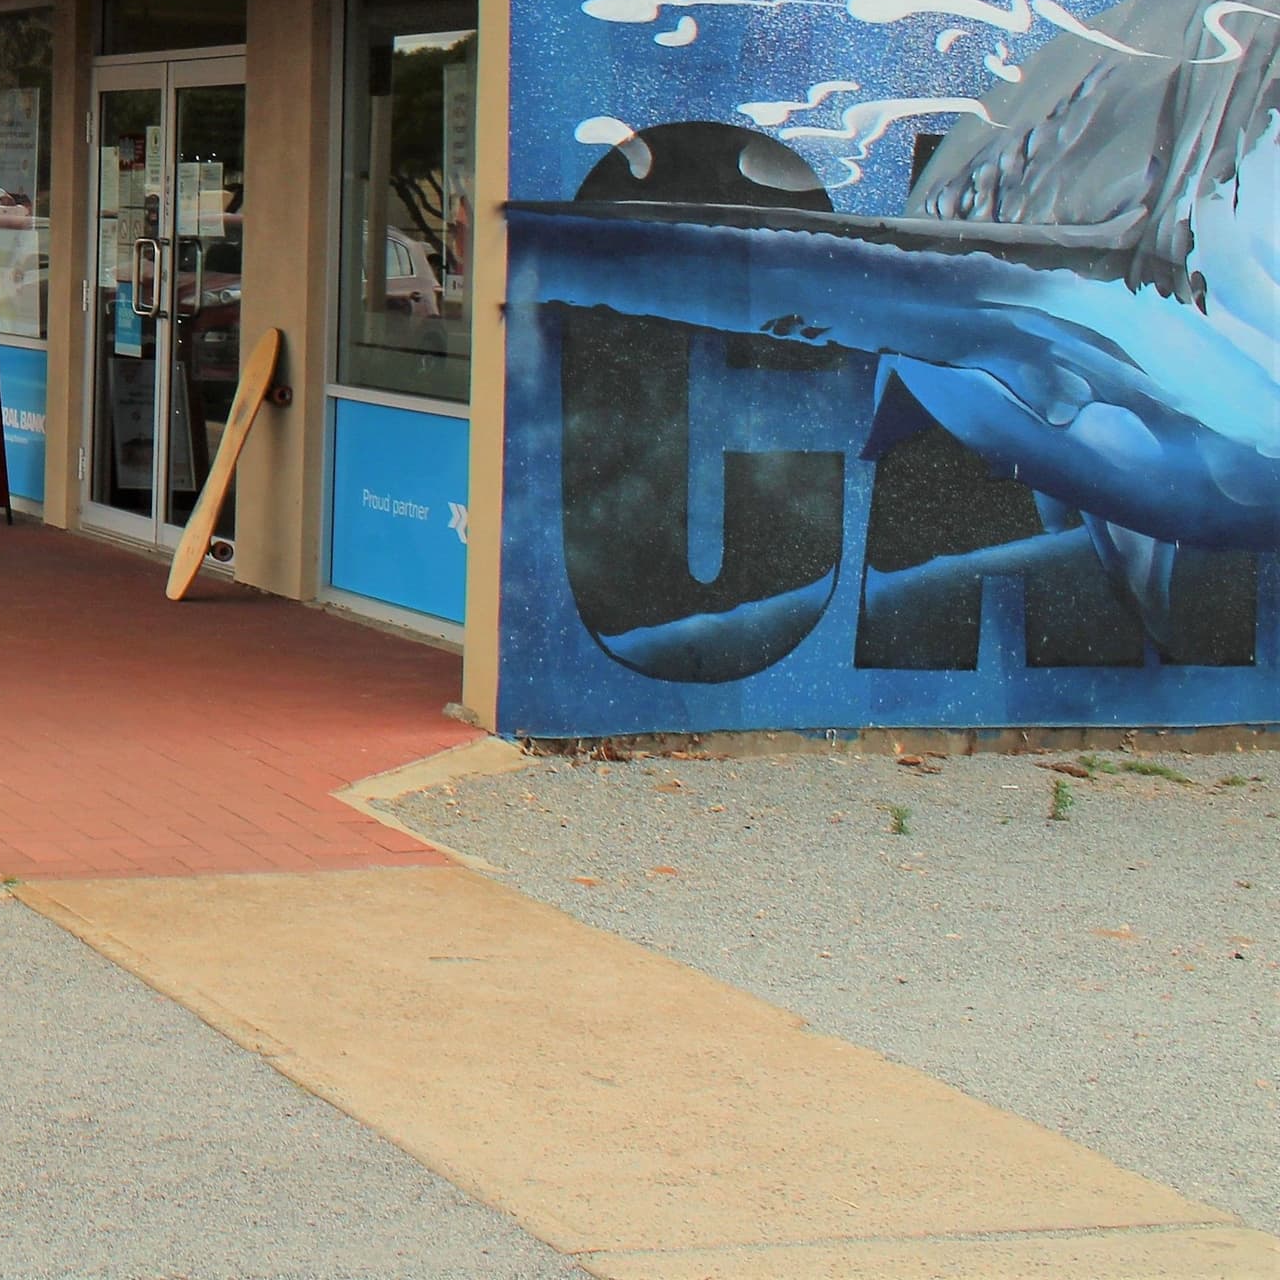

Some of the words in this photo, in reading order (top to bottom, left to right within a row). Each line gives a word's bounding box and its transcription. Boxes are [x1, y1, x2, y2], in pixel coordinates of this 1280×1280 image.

[1, 406, 19, 429] RAL
[363, 488, 390, 512] Proud
[392, 499, 430, 521] partner
